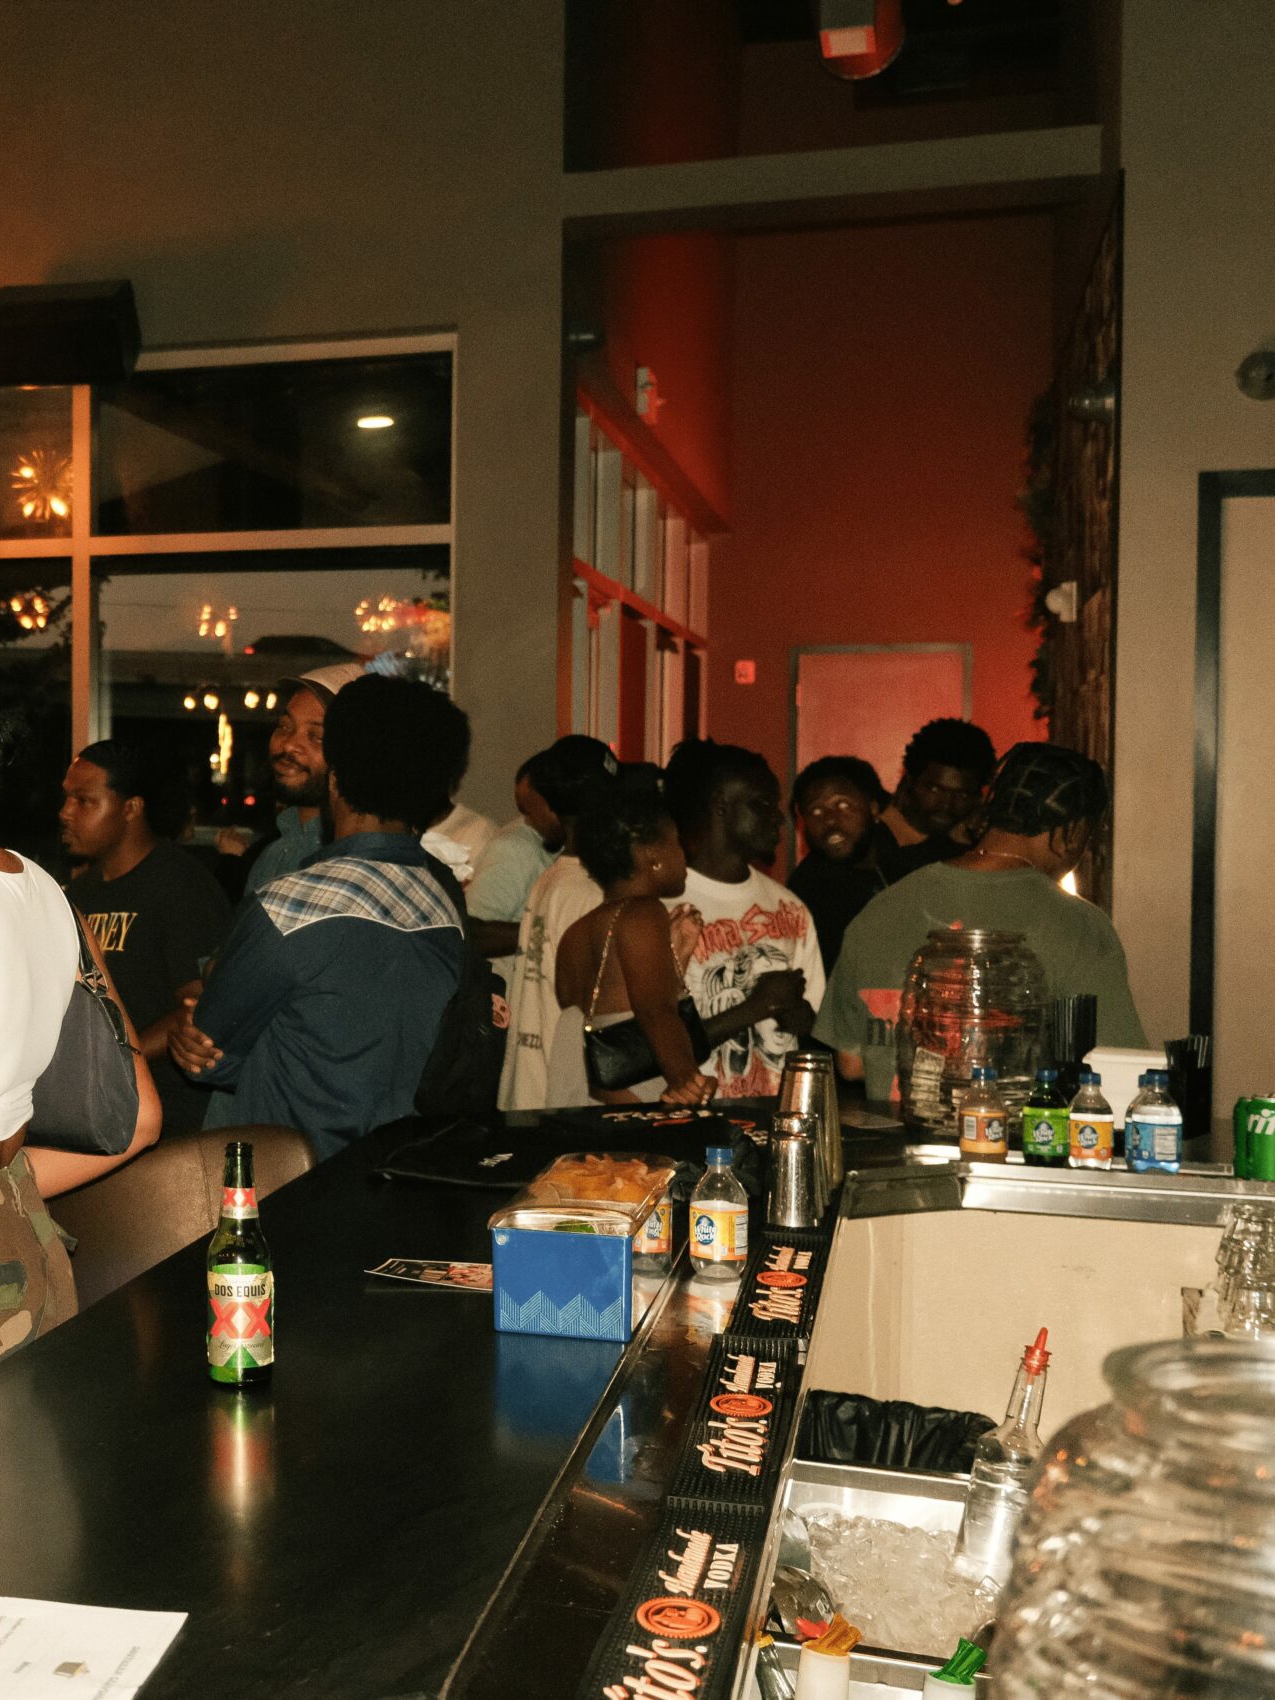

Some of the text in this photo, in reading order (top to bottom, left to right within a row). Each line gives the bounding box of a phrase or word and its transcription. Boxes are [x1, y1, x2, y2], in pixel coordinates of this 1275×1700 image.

[86, 911, 138, 951] TNEY
[694, 1223, 716, 1235] White
[214, 1283, 266, 1298] DOS EQUIS
[210, 1298, 271, 1339] XX
[755, 1362, 777, 1388] VODKA
[658, 1528, 712, 1597] Handmade
[703, 1543, 739, 1589] VODKA
